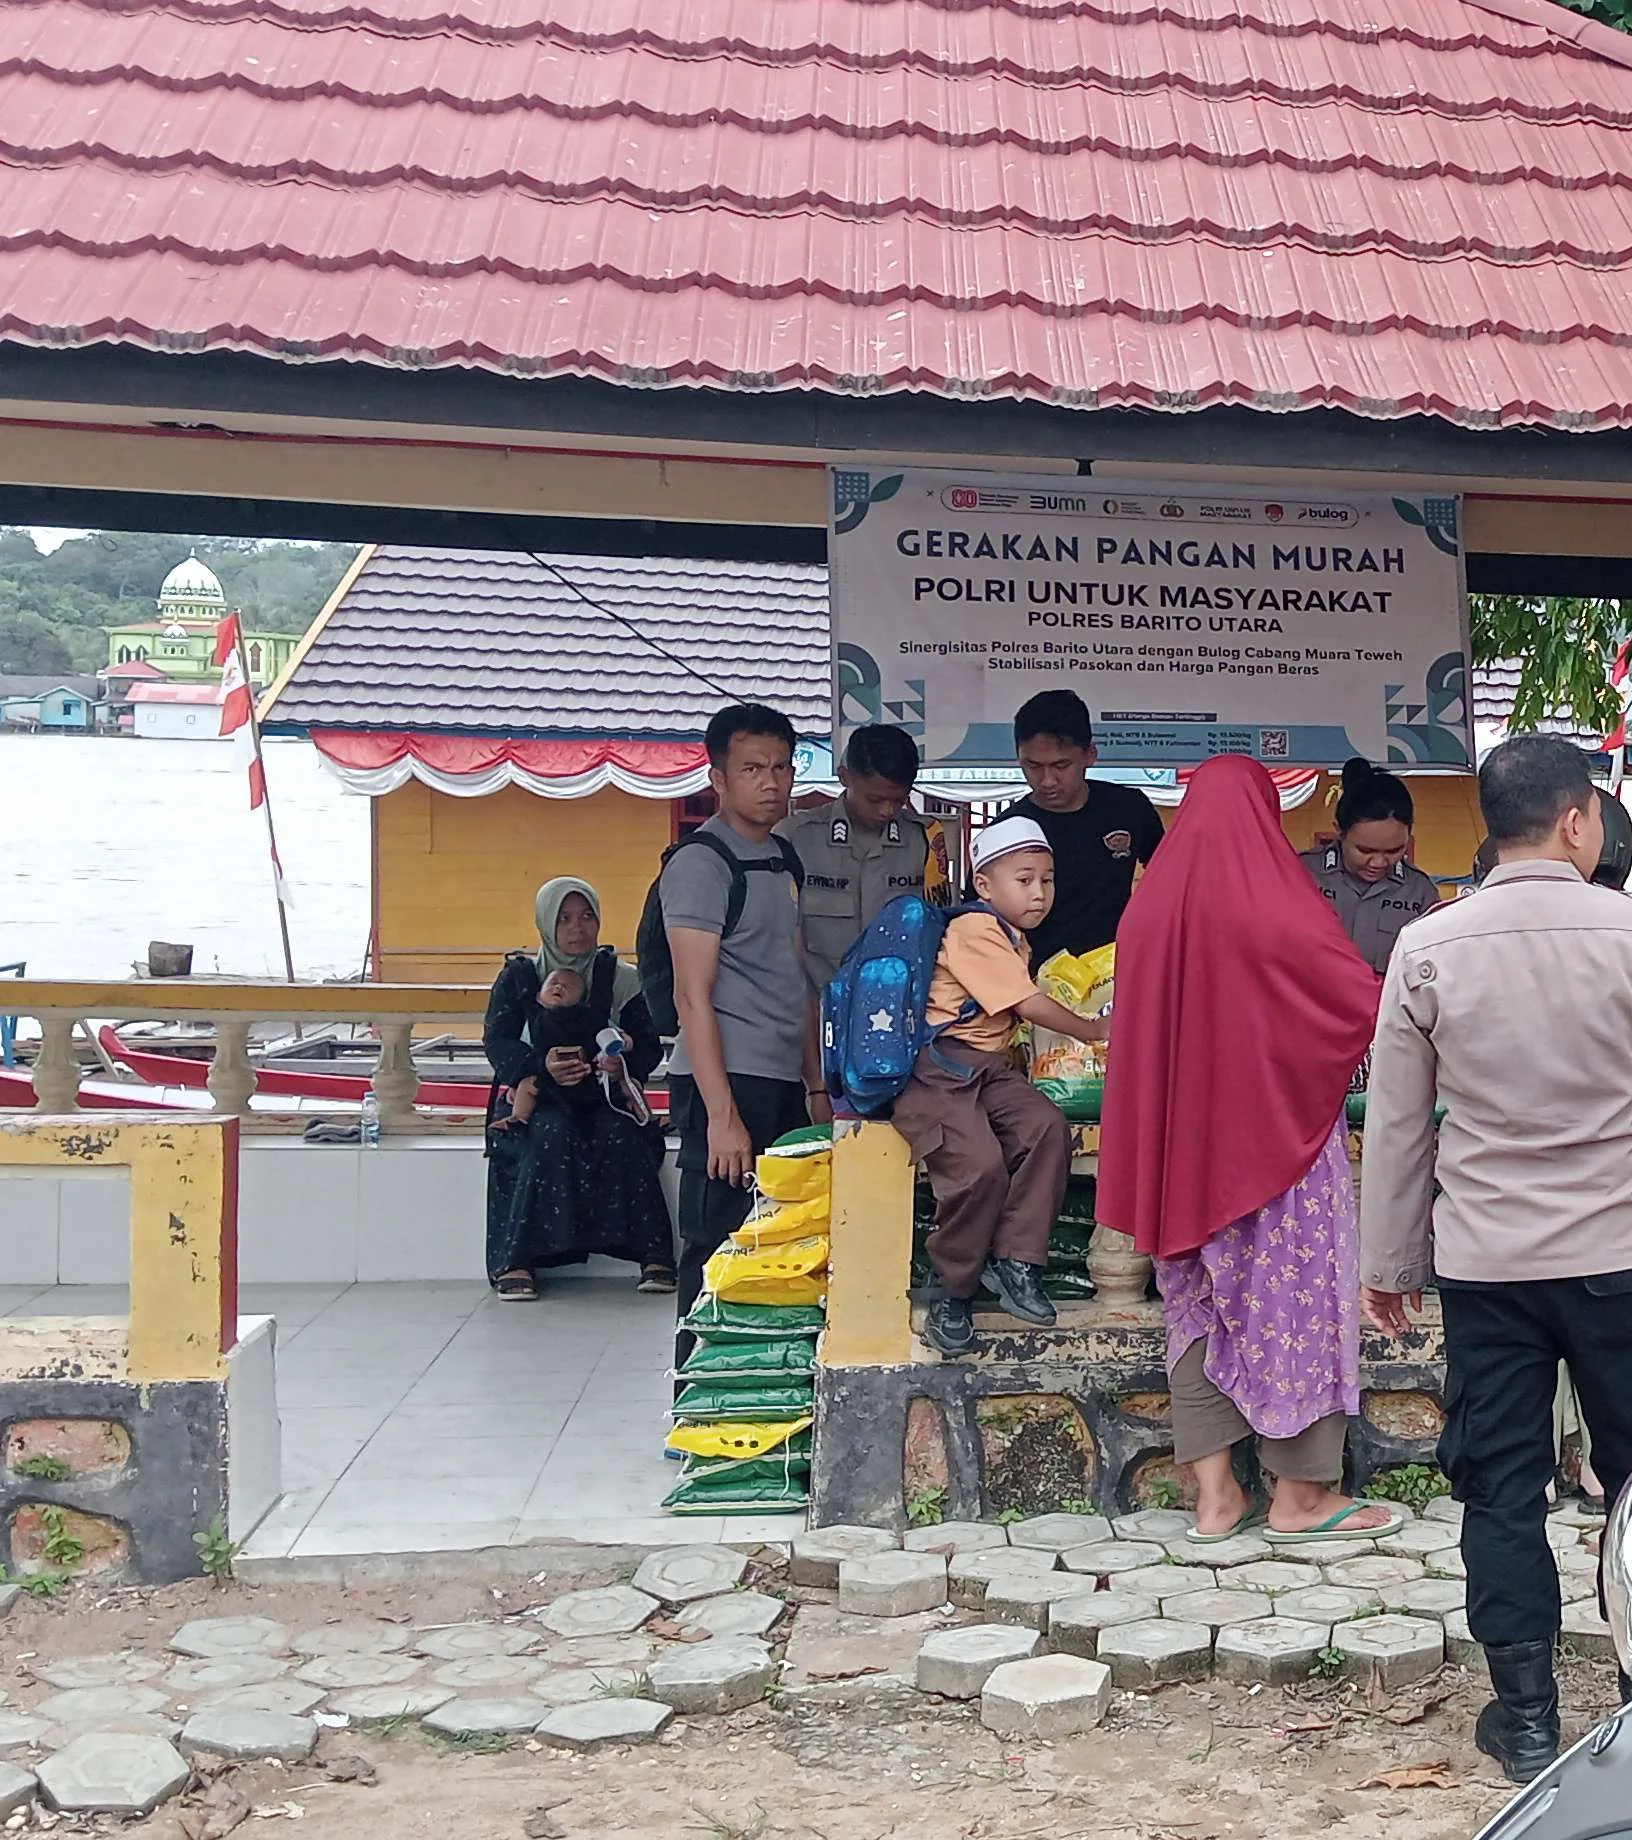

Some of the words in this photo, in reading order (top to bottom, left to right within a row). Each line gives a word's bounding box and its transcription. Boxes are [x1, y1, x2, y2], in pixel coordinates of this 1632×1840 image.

[1309, 507, 1349, 521] bulog
[896, 529, 1080, 564] GERAKAN
[1096, 537, 1256, 570] PANGAN
[1272, 544, 1405, 574] MURAH
[914, 577, 1016, 603] POLRI
[1027, 580, 1149, 607] UNTUK
[1159, 585, 1393, 614] MASYARAKAT
[1028, 611, 1114, 629] POLRES
[1120, 614, 1202, 631] BARITO
[1209, 616, 1284, 633] UTARA
[899, 641, 987, 656] Sinergisitas
[991, 641, 1038, 654] Polres
[1043, 642, 1088, 655] Barito
[1093, 643, 1134, 656] Utara
[1138, 644, 1193, 660] dengan
[1198, 645, 1241, 660] Bulog
[1245, 646, 1301, 662] Cabang
[1305, 648, 1351, 661] Muara
[1354, 649, 1403, 661] Teweh
[988, 657, 1065, 671] Stabilisasi
[1069, 659, 1133, 672] Pasokan
[1137, 660, 1165, 673] dan
[1169, 661, 1214, 676] Harga
[1218, 662, 1273, 676] Pangan
[1278, 663, 1320, 676] Beras
[1381, 899, 1422, 914] POLR
